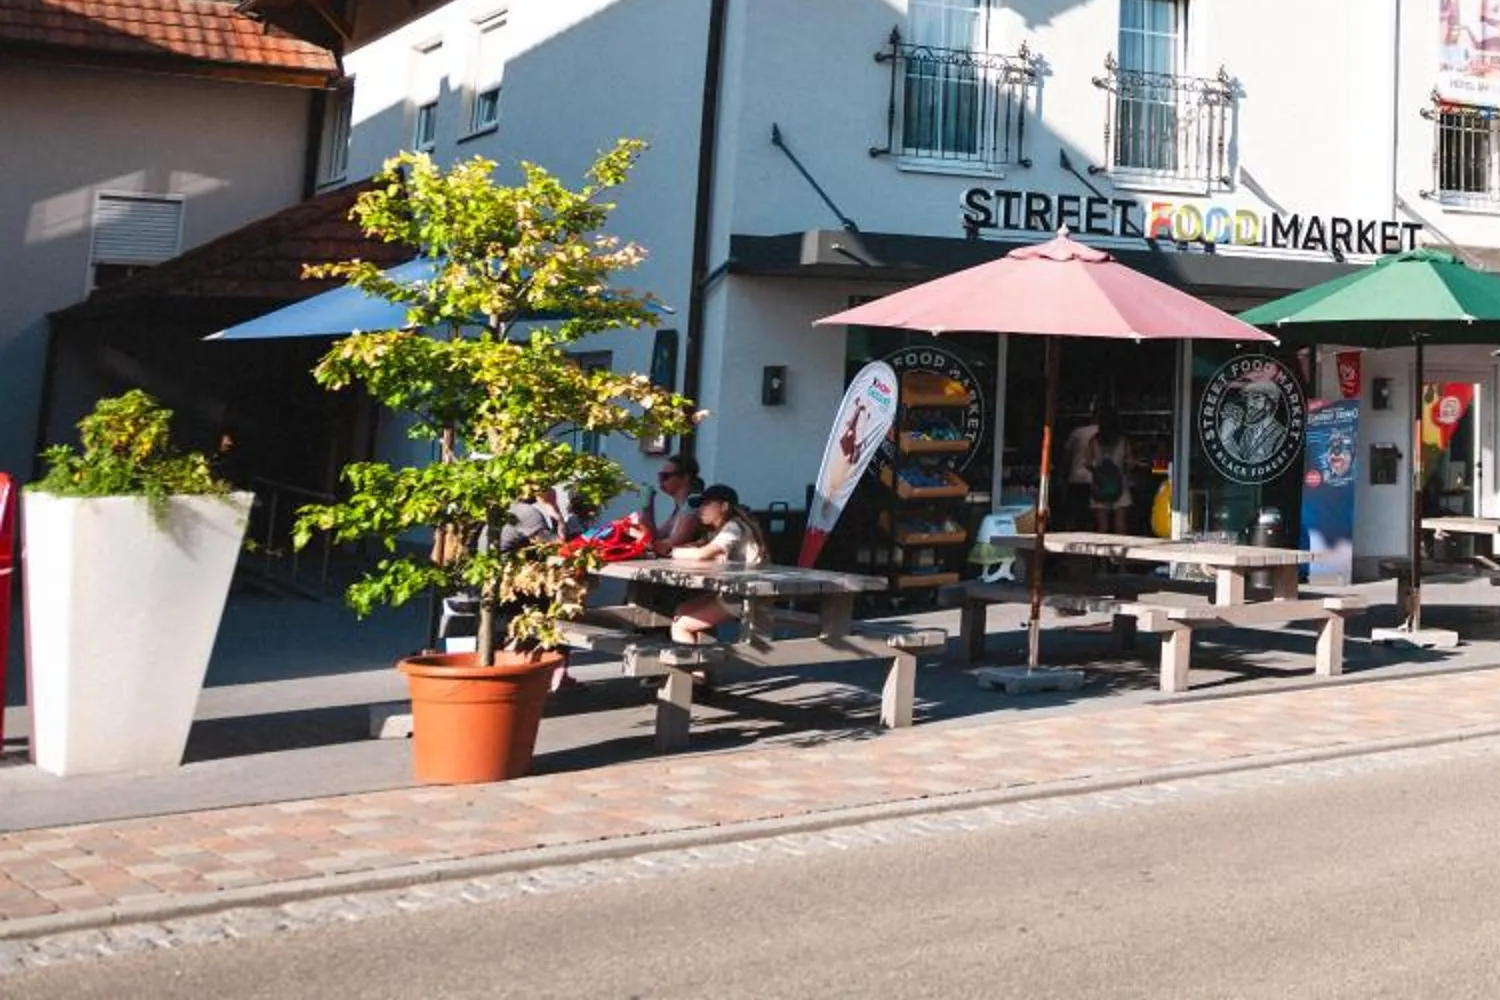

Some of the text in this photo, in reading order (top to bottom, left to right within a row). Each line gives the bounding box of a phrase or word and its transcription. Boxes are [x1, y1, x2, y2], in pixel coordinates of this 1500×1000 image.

[963, 187, 1424, 255] STREET FOOD MARKET
[1203, 373, 1229, 441] STREET
[1230, 359, 1277, 377] FOOD
[1274, 371, 1303, 441] MARKET
[1215, 450, 1248, 478] BLACK
[1250, 450, 1288, 478] FOREST
